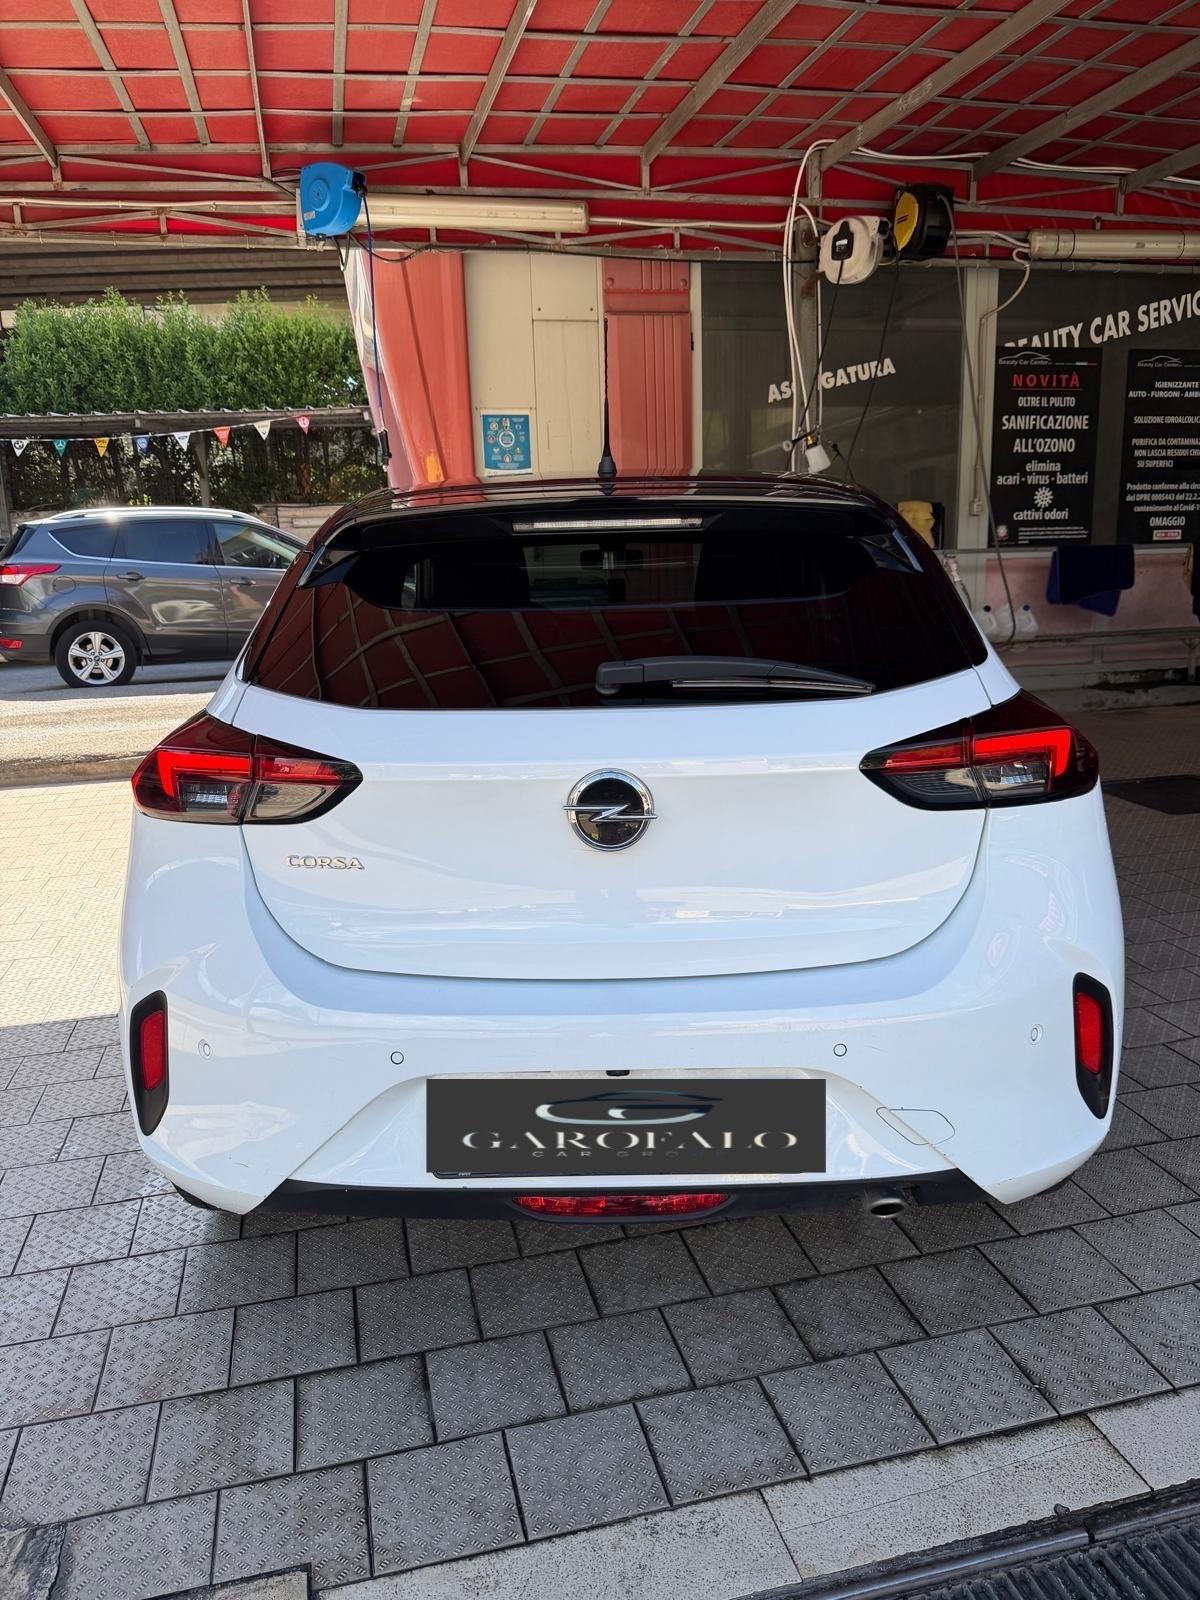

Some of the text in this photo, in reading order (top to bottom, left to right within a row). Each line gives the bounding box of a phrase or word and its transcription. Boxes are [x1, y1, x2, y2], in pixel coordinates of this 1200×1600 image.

[1090, 310, 1132, 345] CAR
[768, 358, 896, 403] ASGATURA
[1012, 371, 1080, 387] NOVITÀ
[1155, 381, 1200, 389] IGIENIZZANTE
[1018, 397, 1076, 407] OLTRE IL PULITO
[1002, 415, 1089, 430] SANIFICAZIONE
[1134, 416, 1164, 424] SOLUZIONE
[1132, 438, 1158, 446] PURIFICA
[1158, 438, 1166, 446] DA
[1148, 449, 1167, 457] LASCIA
[1026, 460, 1061, 472] elimina
[1137, 460, 1145, 468] SU
[997, 473, 1020, 485] acari
[1027, 472, 1050, 484] virus
[1056, 472, 1088, 484] batteri
[1152, 482, 1178, 490] conforme
[1179, 482, 1190, 490] alla
[1013, 508, 1069, 520] cattivi odori
[1149, 516, 1186, 526] OMAGGIO
[285, 855, 366, 870] CORSA
